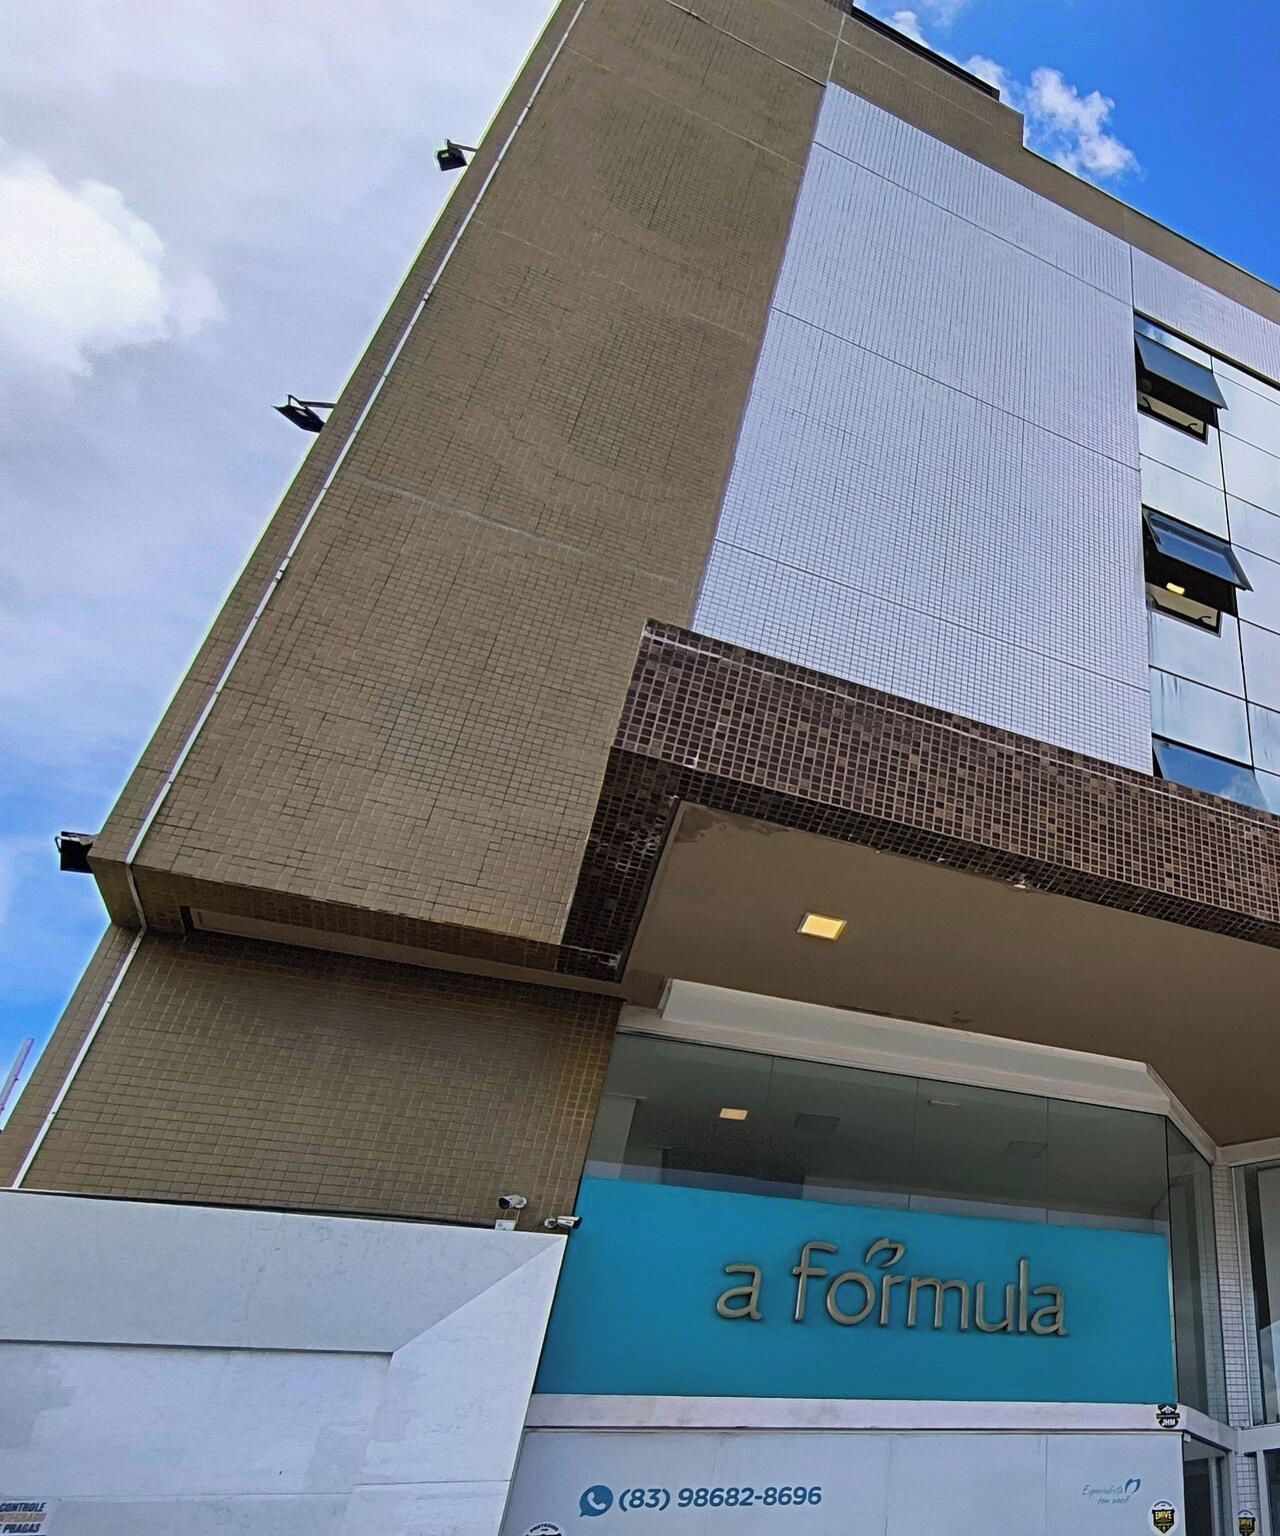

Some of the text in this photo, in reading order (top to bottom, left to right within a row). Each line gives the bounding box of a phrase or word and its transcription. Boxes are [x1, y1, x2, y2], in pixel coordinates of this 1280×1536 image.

[716, 1264, 763, 1321] a
[618, 1486, 823, 1512] (83) 98682-8696
